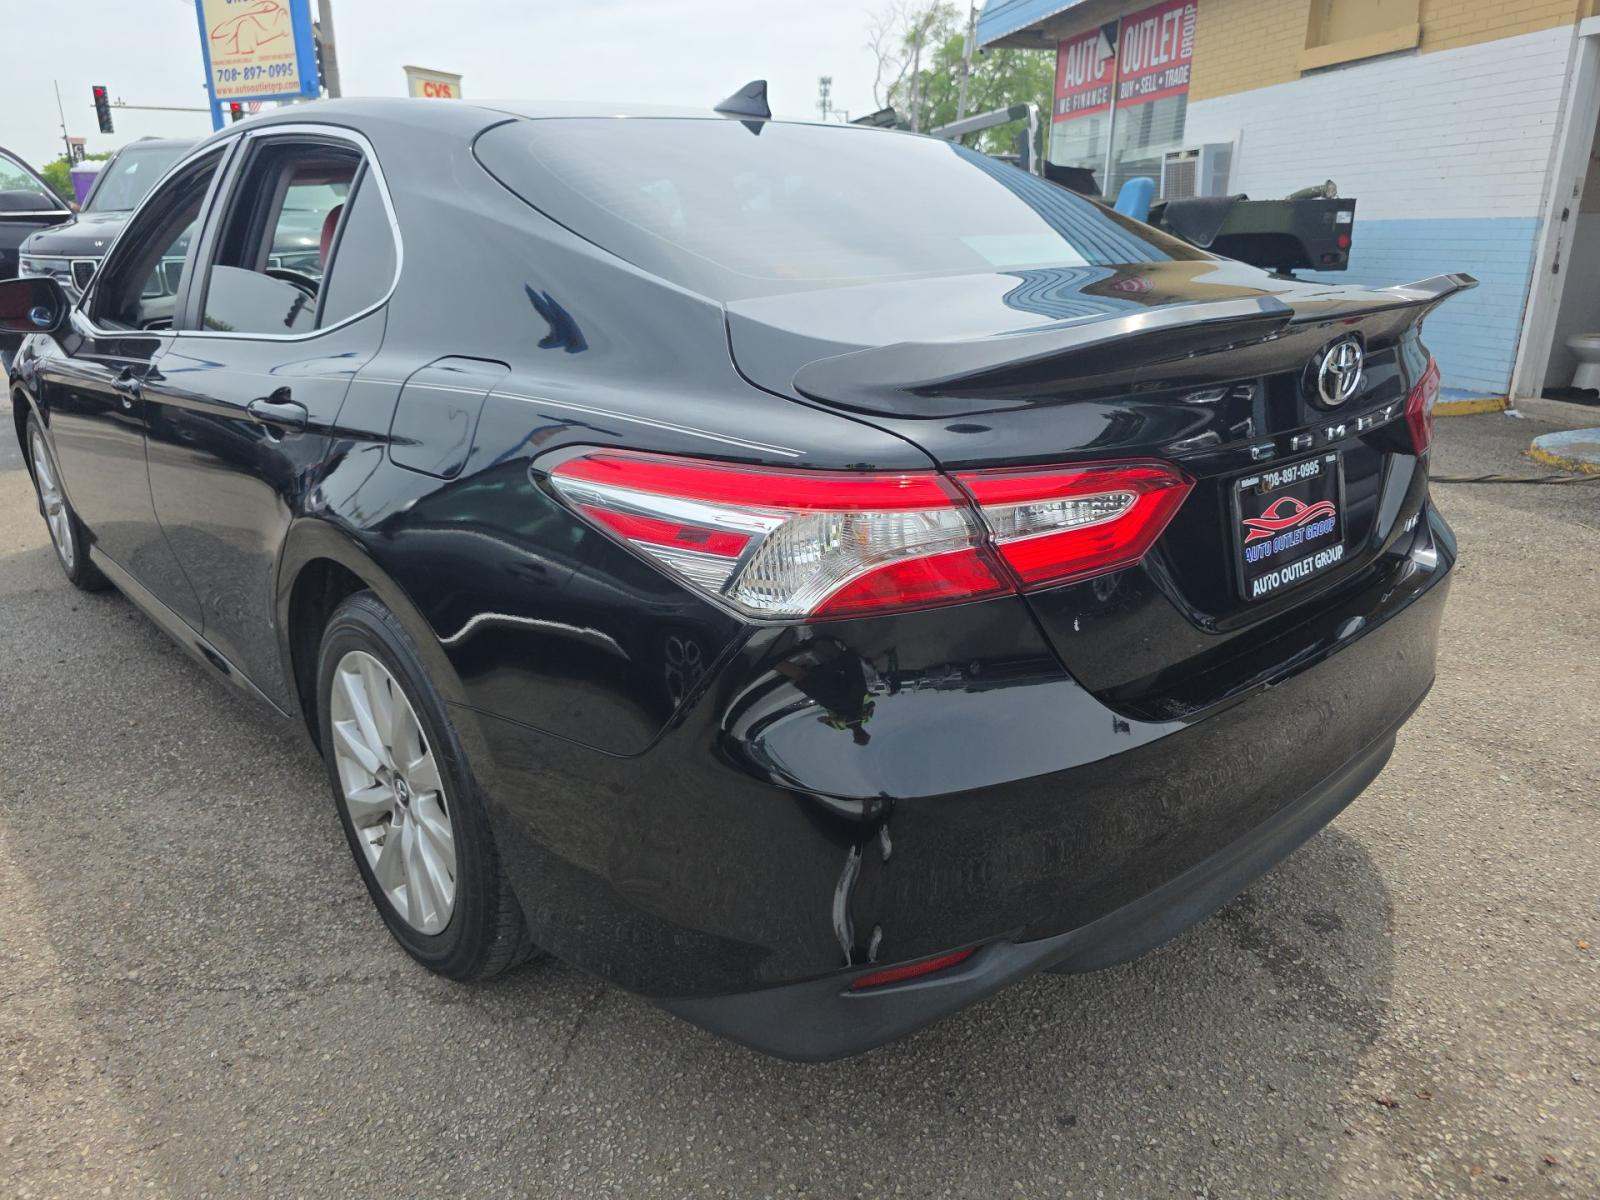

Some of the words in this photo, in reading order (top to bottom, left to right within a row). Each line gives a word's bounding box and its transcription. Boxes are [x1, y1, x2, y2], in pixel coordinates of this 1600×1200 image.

[1122, 8, 1183, 75] OUTLET
[1181, 4, 1196, 58] GROUP
[217, 62, 293, 82] 708-897-0995
[1120, 81, 1134, 99] BUY
[1140, 74, 1157, 94] SELL
[1165, 65, 1190, 88] TRADE
[424, 81, 452, 98] CVS
[1060, 98, 1071, 114] WE
[1073, 87, 1108, 110] FINANCE
[1263, 460, 1319, 488] 708-897-0995
[1273, 527, 1305, 553] OUTLET
[1305, 517, 1335, 540] GROUP
[1253, 572, 1280, 597] AUTO
[1281, 556, 1314, 583] OUTLET
[1314, 545, 1343, 568] GROUP
